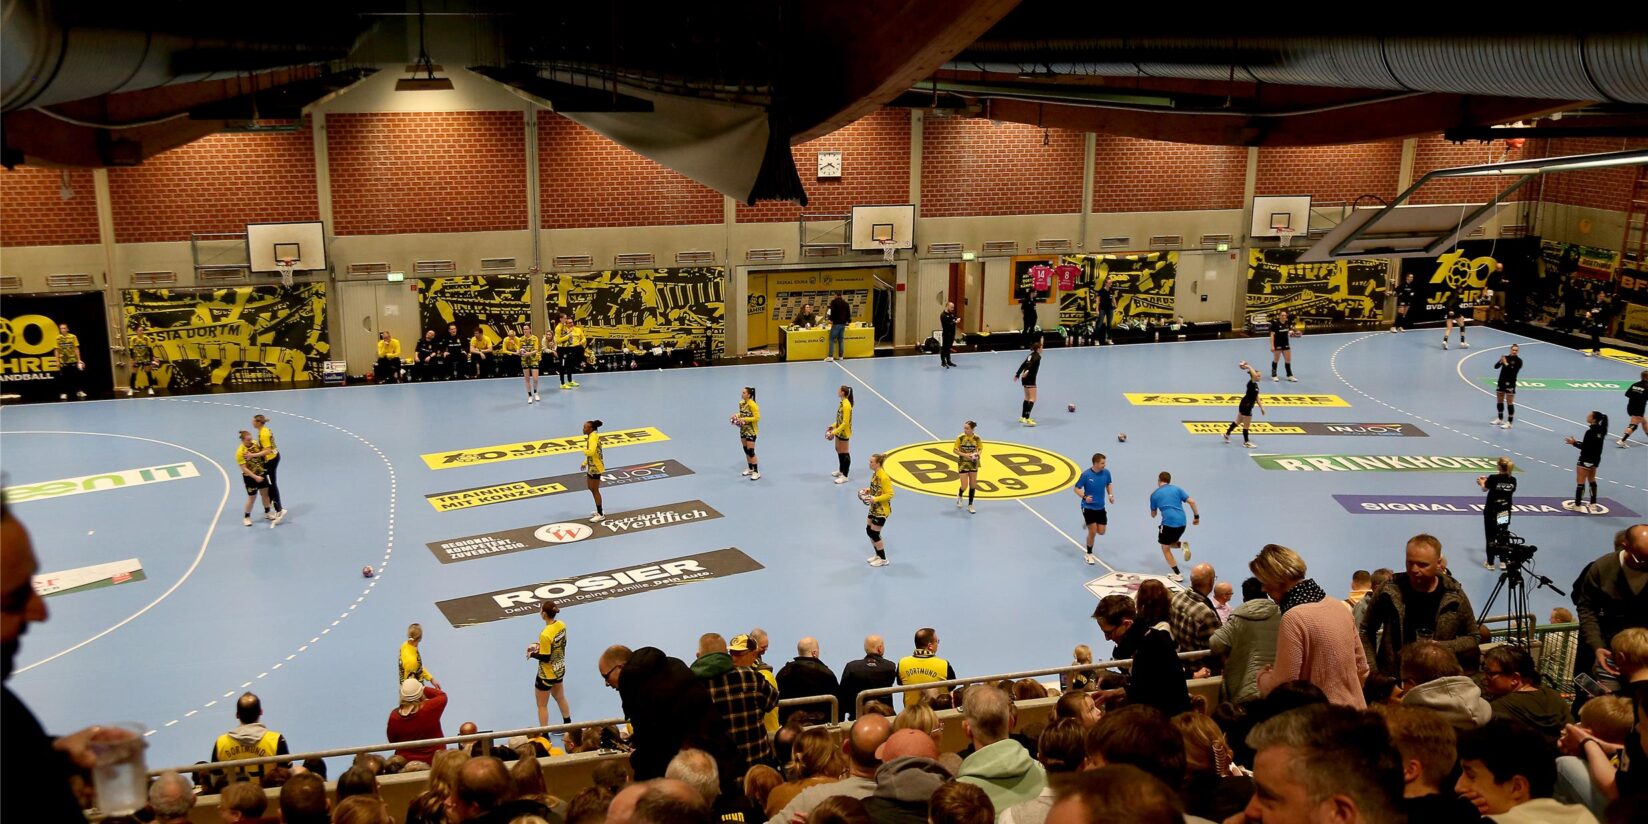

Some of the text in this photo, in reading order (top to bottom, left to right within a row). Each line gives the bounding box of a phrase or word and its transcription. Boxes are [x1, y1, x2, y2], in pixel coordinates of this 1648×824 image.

[509, 430, 652, 453] JAHRE
[139, 463, 187, 481] IT
[599, 465, 666, 482] NJOY
[436, 484, 525, 502] TRAINING
[441, 485, 559, 510] MIT KONZEPT
[1360, 502, 1563, 513] SIGNAL INA
[492, 558, 707, 609] ROSIER
[504, 603, 533, 614] Dein
[533, 597, 575, 610] Vein.
[576, 591, 609, 602] Deine
[653, 577, 680, 588] Dein
[906, 667, 938, 678] DORTMUND
[225, 744, 266, 758] DORTMUND
